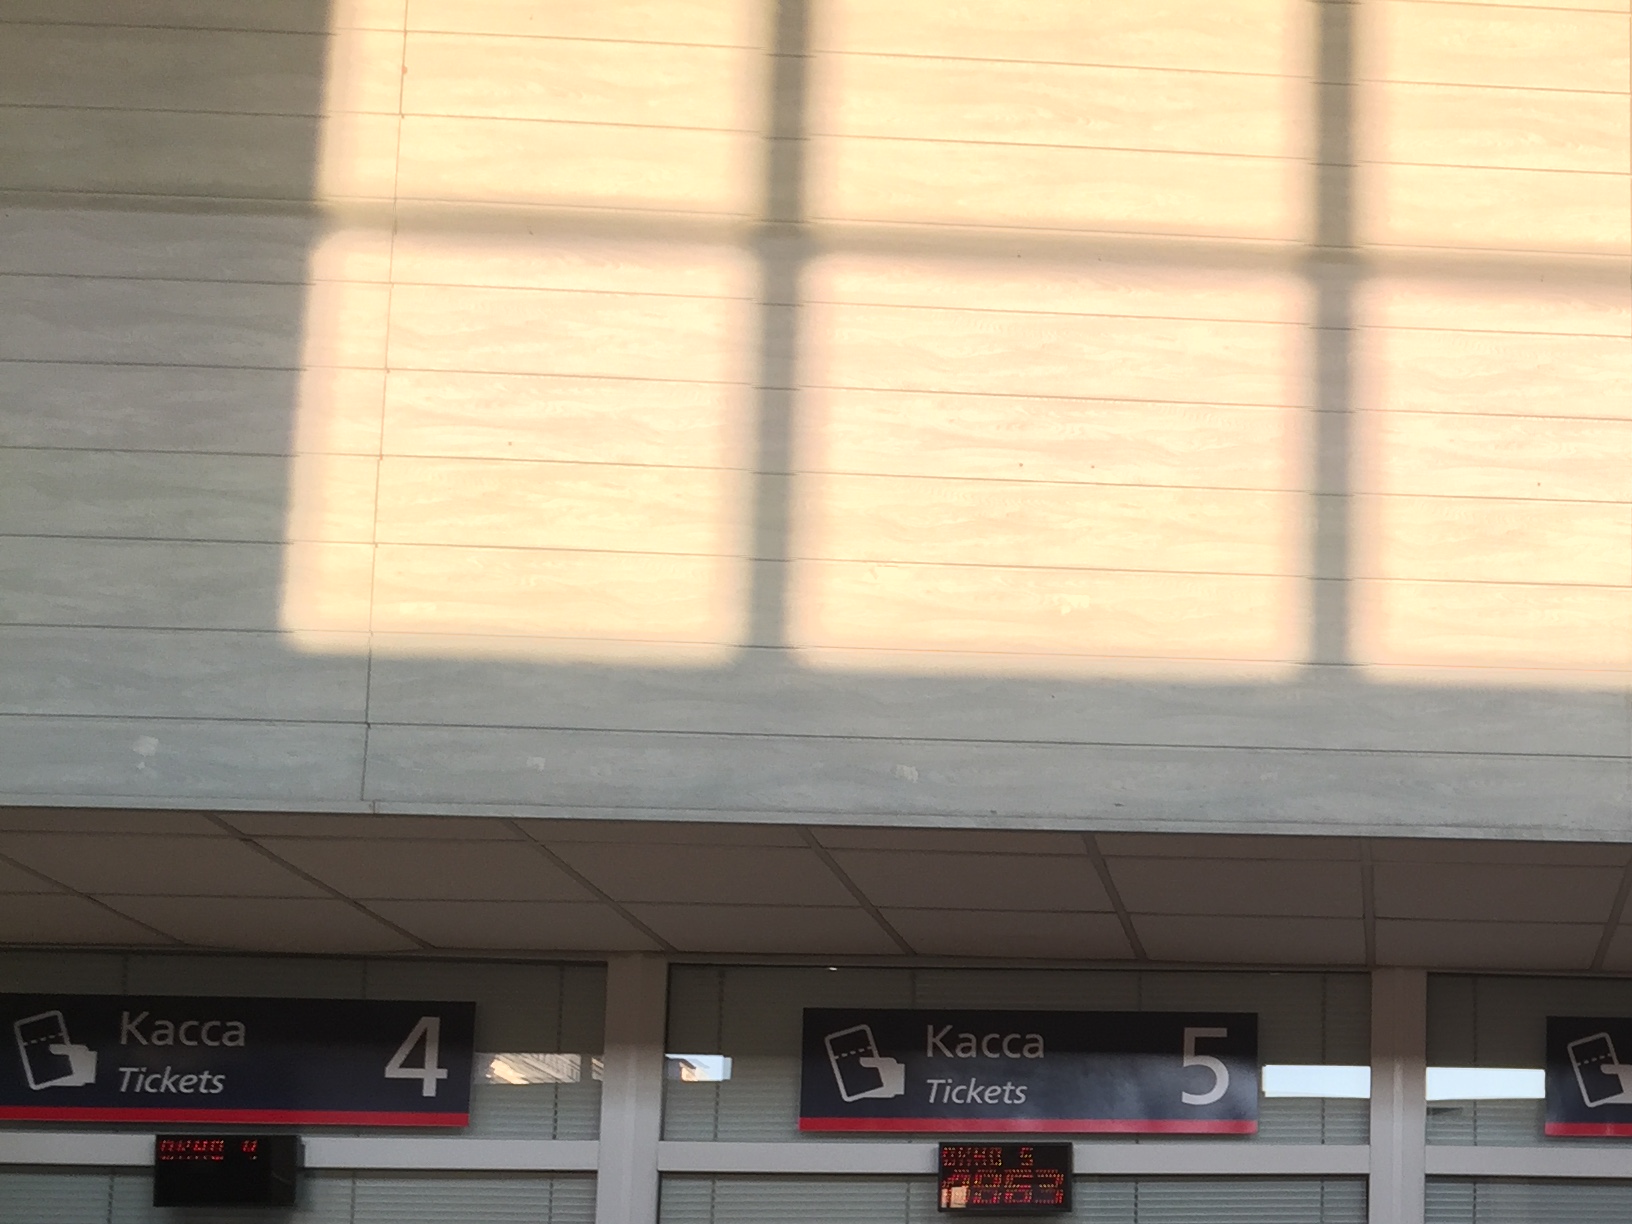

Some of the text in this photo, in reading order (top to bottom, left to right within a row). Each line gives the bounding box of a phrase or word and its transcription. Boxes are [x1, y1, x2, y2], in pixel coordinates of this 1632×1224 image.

[119, 1010, 448, 1097] Касса 4
[926, 1023, 1230, 1105] Касса 5
[118, 1067, 226, 1096] Tickets
[926, 1078, 1028, 1106] Tickets
